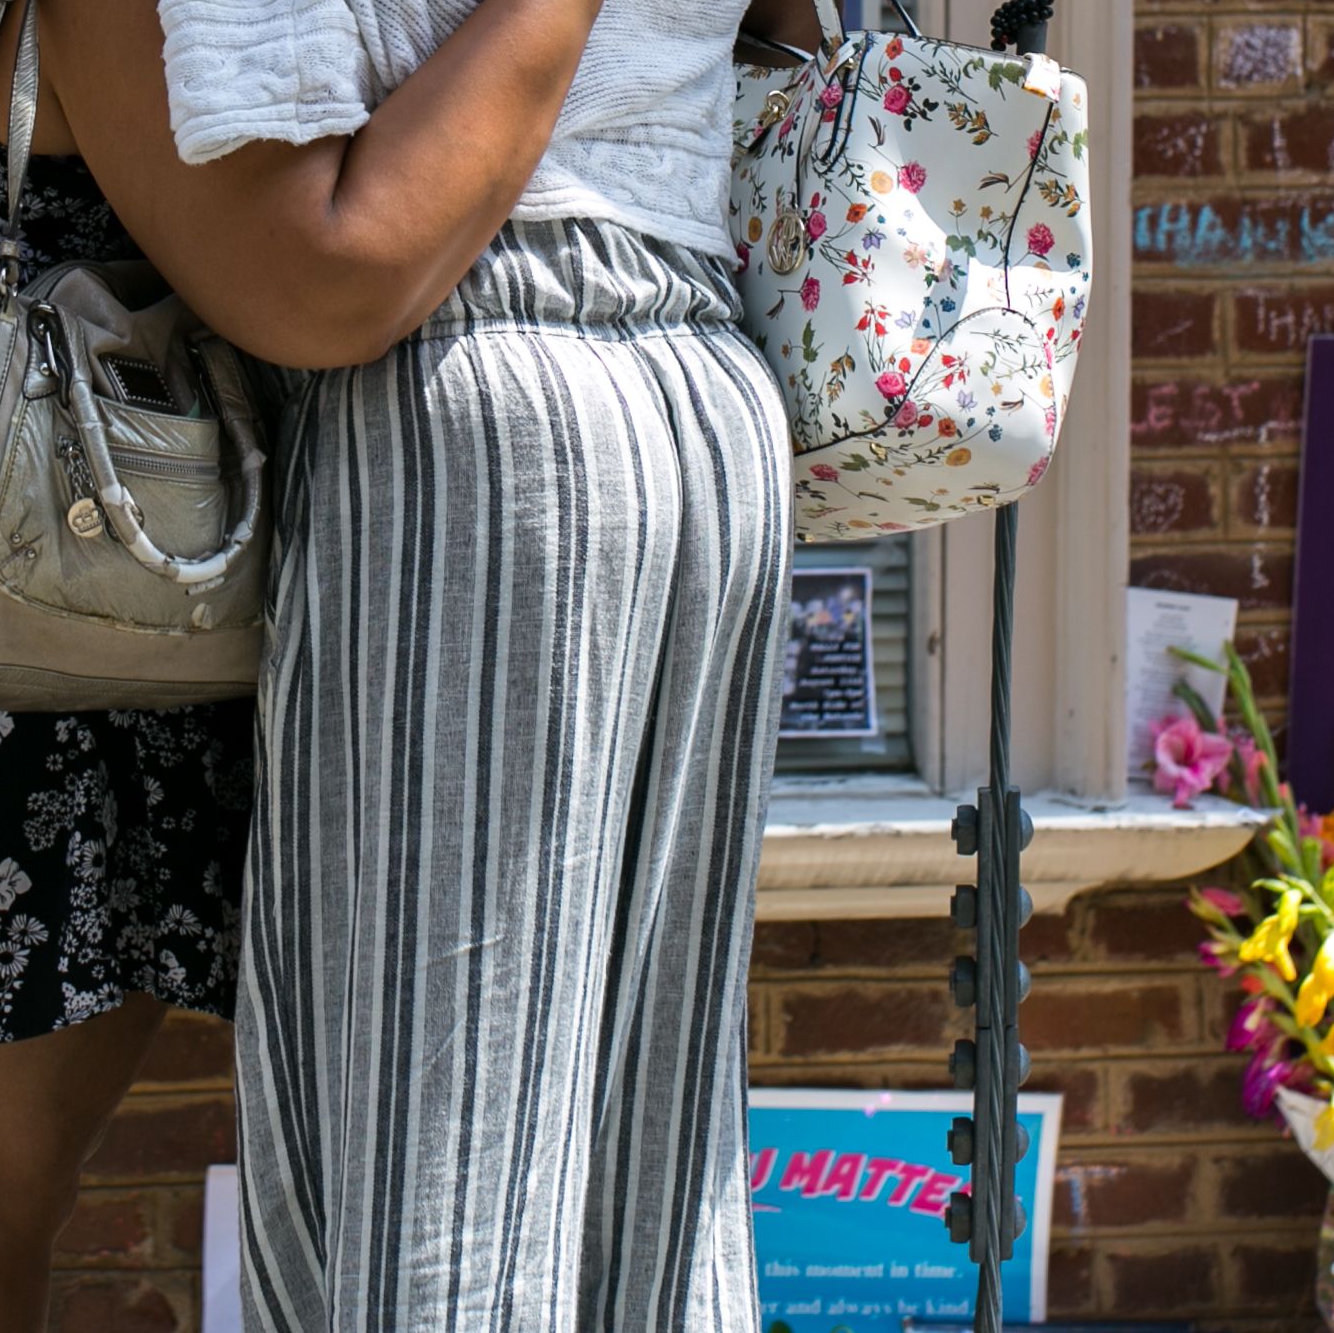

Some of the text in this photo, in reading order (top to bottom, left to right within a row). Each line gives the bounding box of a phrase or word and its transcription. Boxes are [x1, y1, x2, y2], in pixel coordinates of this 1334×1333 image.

[779, 1148, 973, 1220] MATTE
[764, 1258, 800, 1277] this
[805, 1261, 884, 1278] moment
[889, 1260, 909, 1278] in
[785, 1296, 822, 1315] and
[897, 1297, 921, 1315] be
